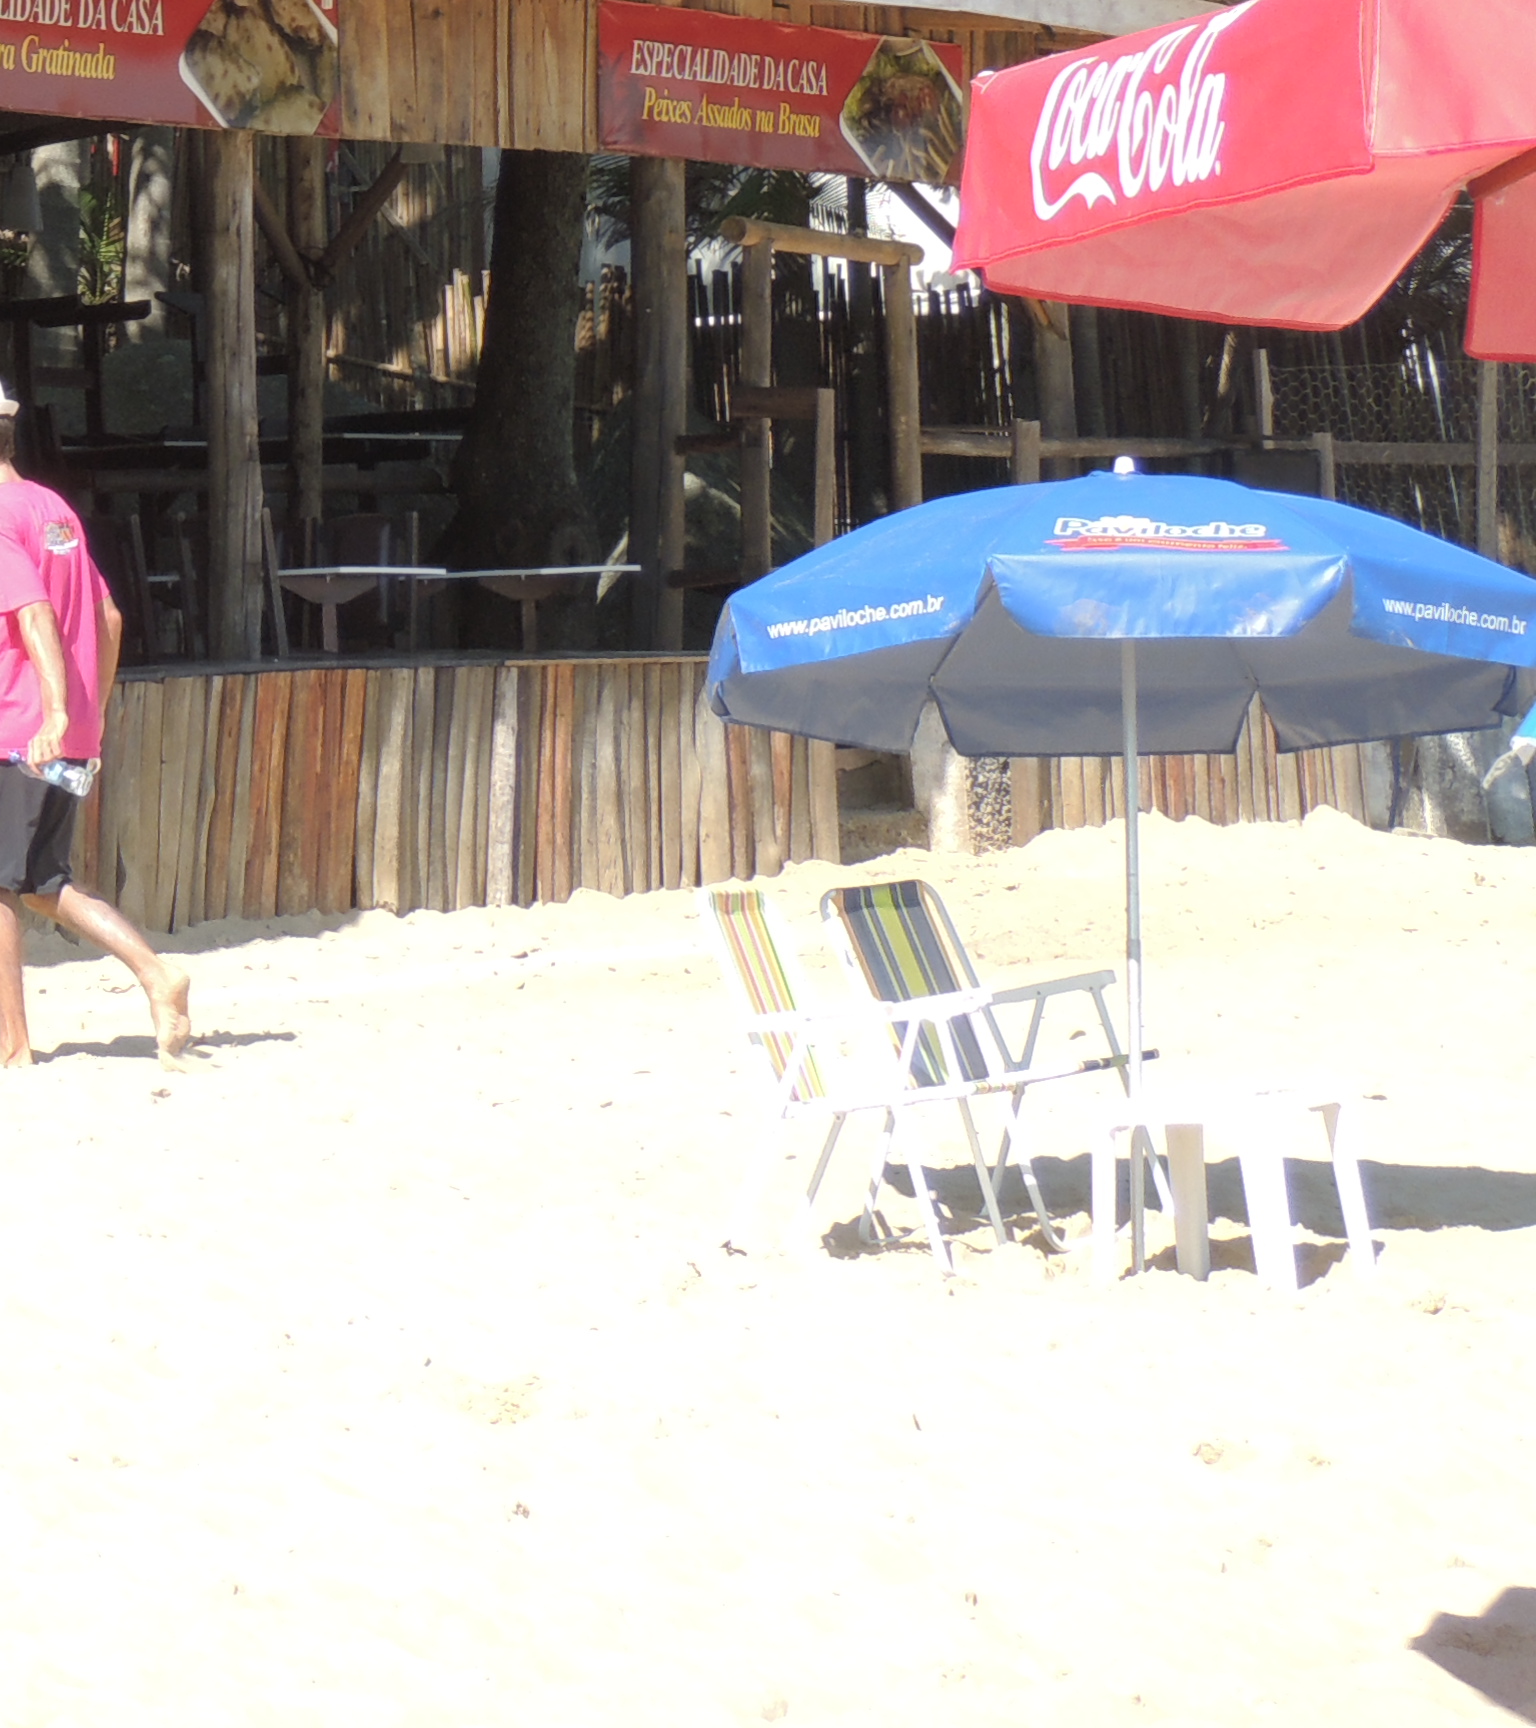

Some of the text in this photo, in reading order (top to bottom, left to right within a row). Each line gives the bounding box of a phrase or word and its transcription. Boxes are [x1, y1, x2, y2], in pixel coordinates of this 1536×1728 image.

[21, 34, 116, 80] Gratinada
[630, 39, 828, 96] ESPECIALIDADE DA CASA
[641, 86, 821, 139] Peixes Assados na Brasa
[767, 594, 945, 640] www.paviloche.com.br
[1381, 598, 1527, 635] www.paviloche.com.br
